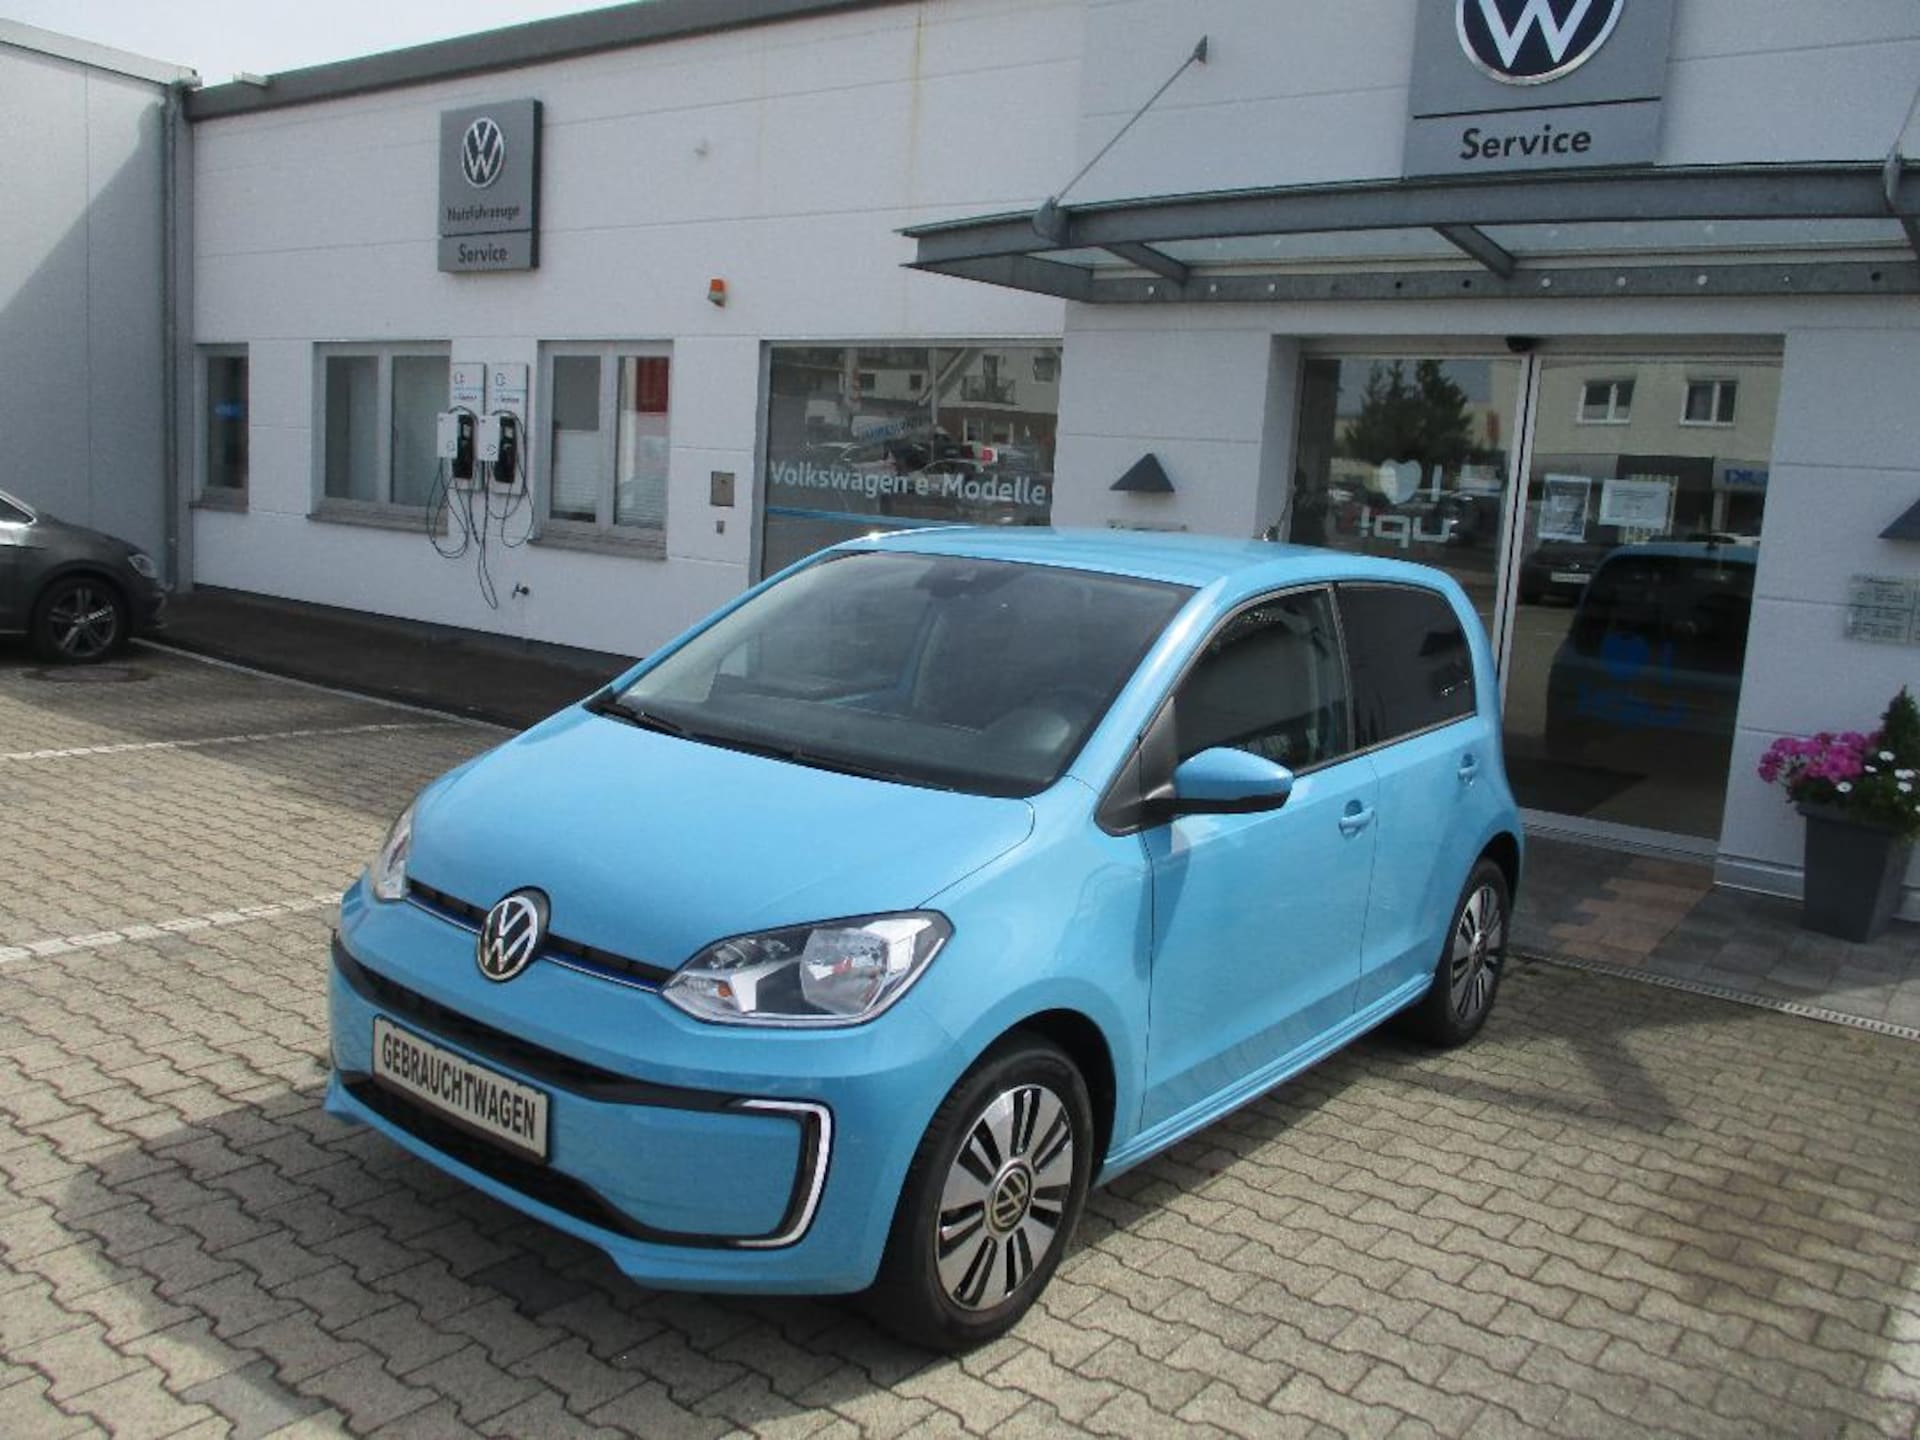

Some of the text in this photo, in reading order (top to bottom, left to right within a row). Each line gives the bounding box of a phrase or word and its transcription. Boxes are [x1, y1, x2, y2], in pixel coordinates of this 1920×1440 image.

[1460, 124, 1592, 160] Service
[458, 242, 508, 264] Service
[769, 459, 1047, 506] Volkswagen e-Modelle
[382, 1032, 537, 1141] GEBRAUCHTWAGEN
